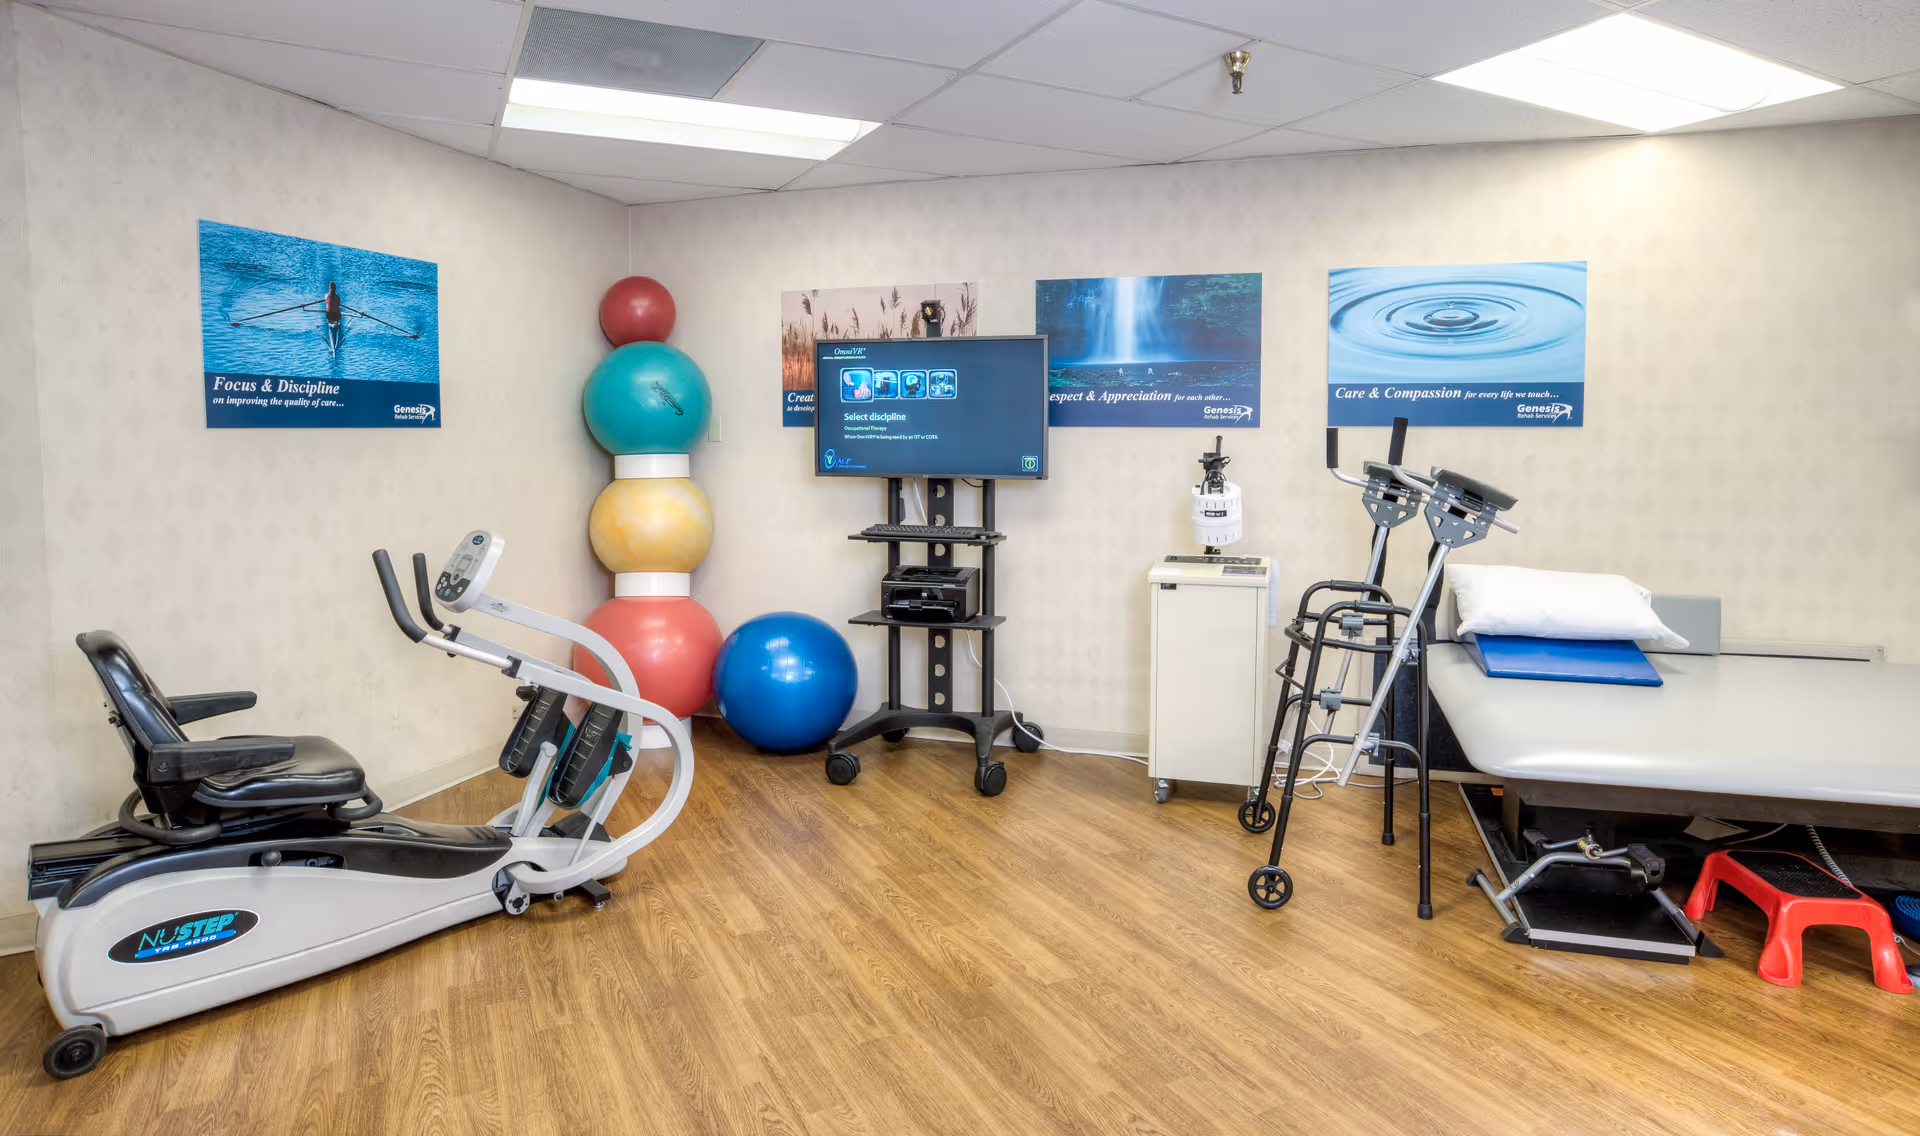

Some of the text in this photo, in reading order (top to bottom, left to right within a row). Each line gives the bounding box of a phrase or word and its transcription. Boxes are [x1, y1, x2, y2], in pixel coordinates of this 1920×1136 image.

[212, 376, 340, 397] Focus & Discipline
[1085, 390, 1096, 402] &
[1097, 390, 1172, 404] Appreciation
[1172, 393, 1186, 403] for
[1186, 393, 1203, 401] each
[1204, 393, 1231, 401] other...
[1335, 387, 1366, 399] Care
[1368, 386, 1380, 399] &
[1384, 386, 1462, 402] Compassion
[1463, 390, 1477, 400] for
[1478, 392, 1499, 400] every
[1500, 390, 1514, 400] life
[1527, 390, 1560, 399] touch...
[212, 395, 345, 409] on improving the quality of care...
[393, 404, 427, 414] Genesis
[1203, 405, 1242, 415] Genesis
[1517, 404, 1561, 414] Genesis
[844, 412, 907, 423] Select discipline
[185, 934, 217, 946] 4000
